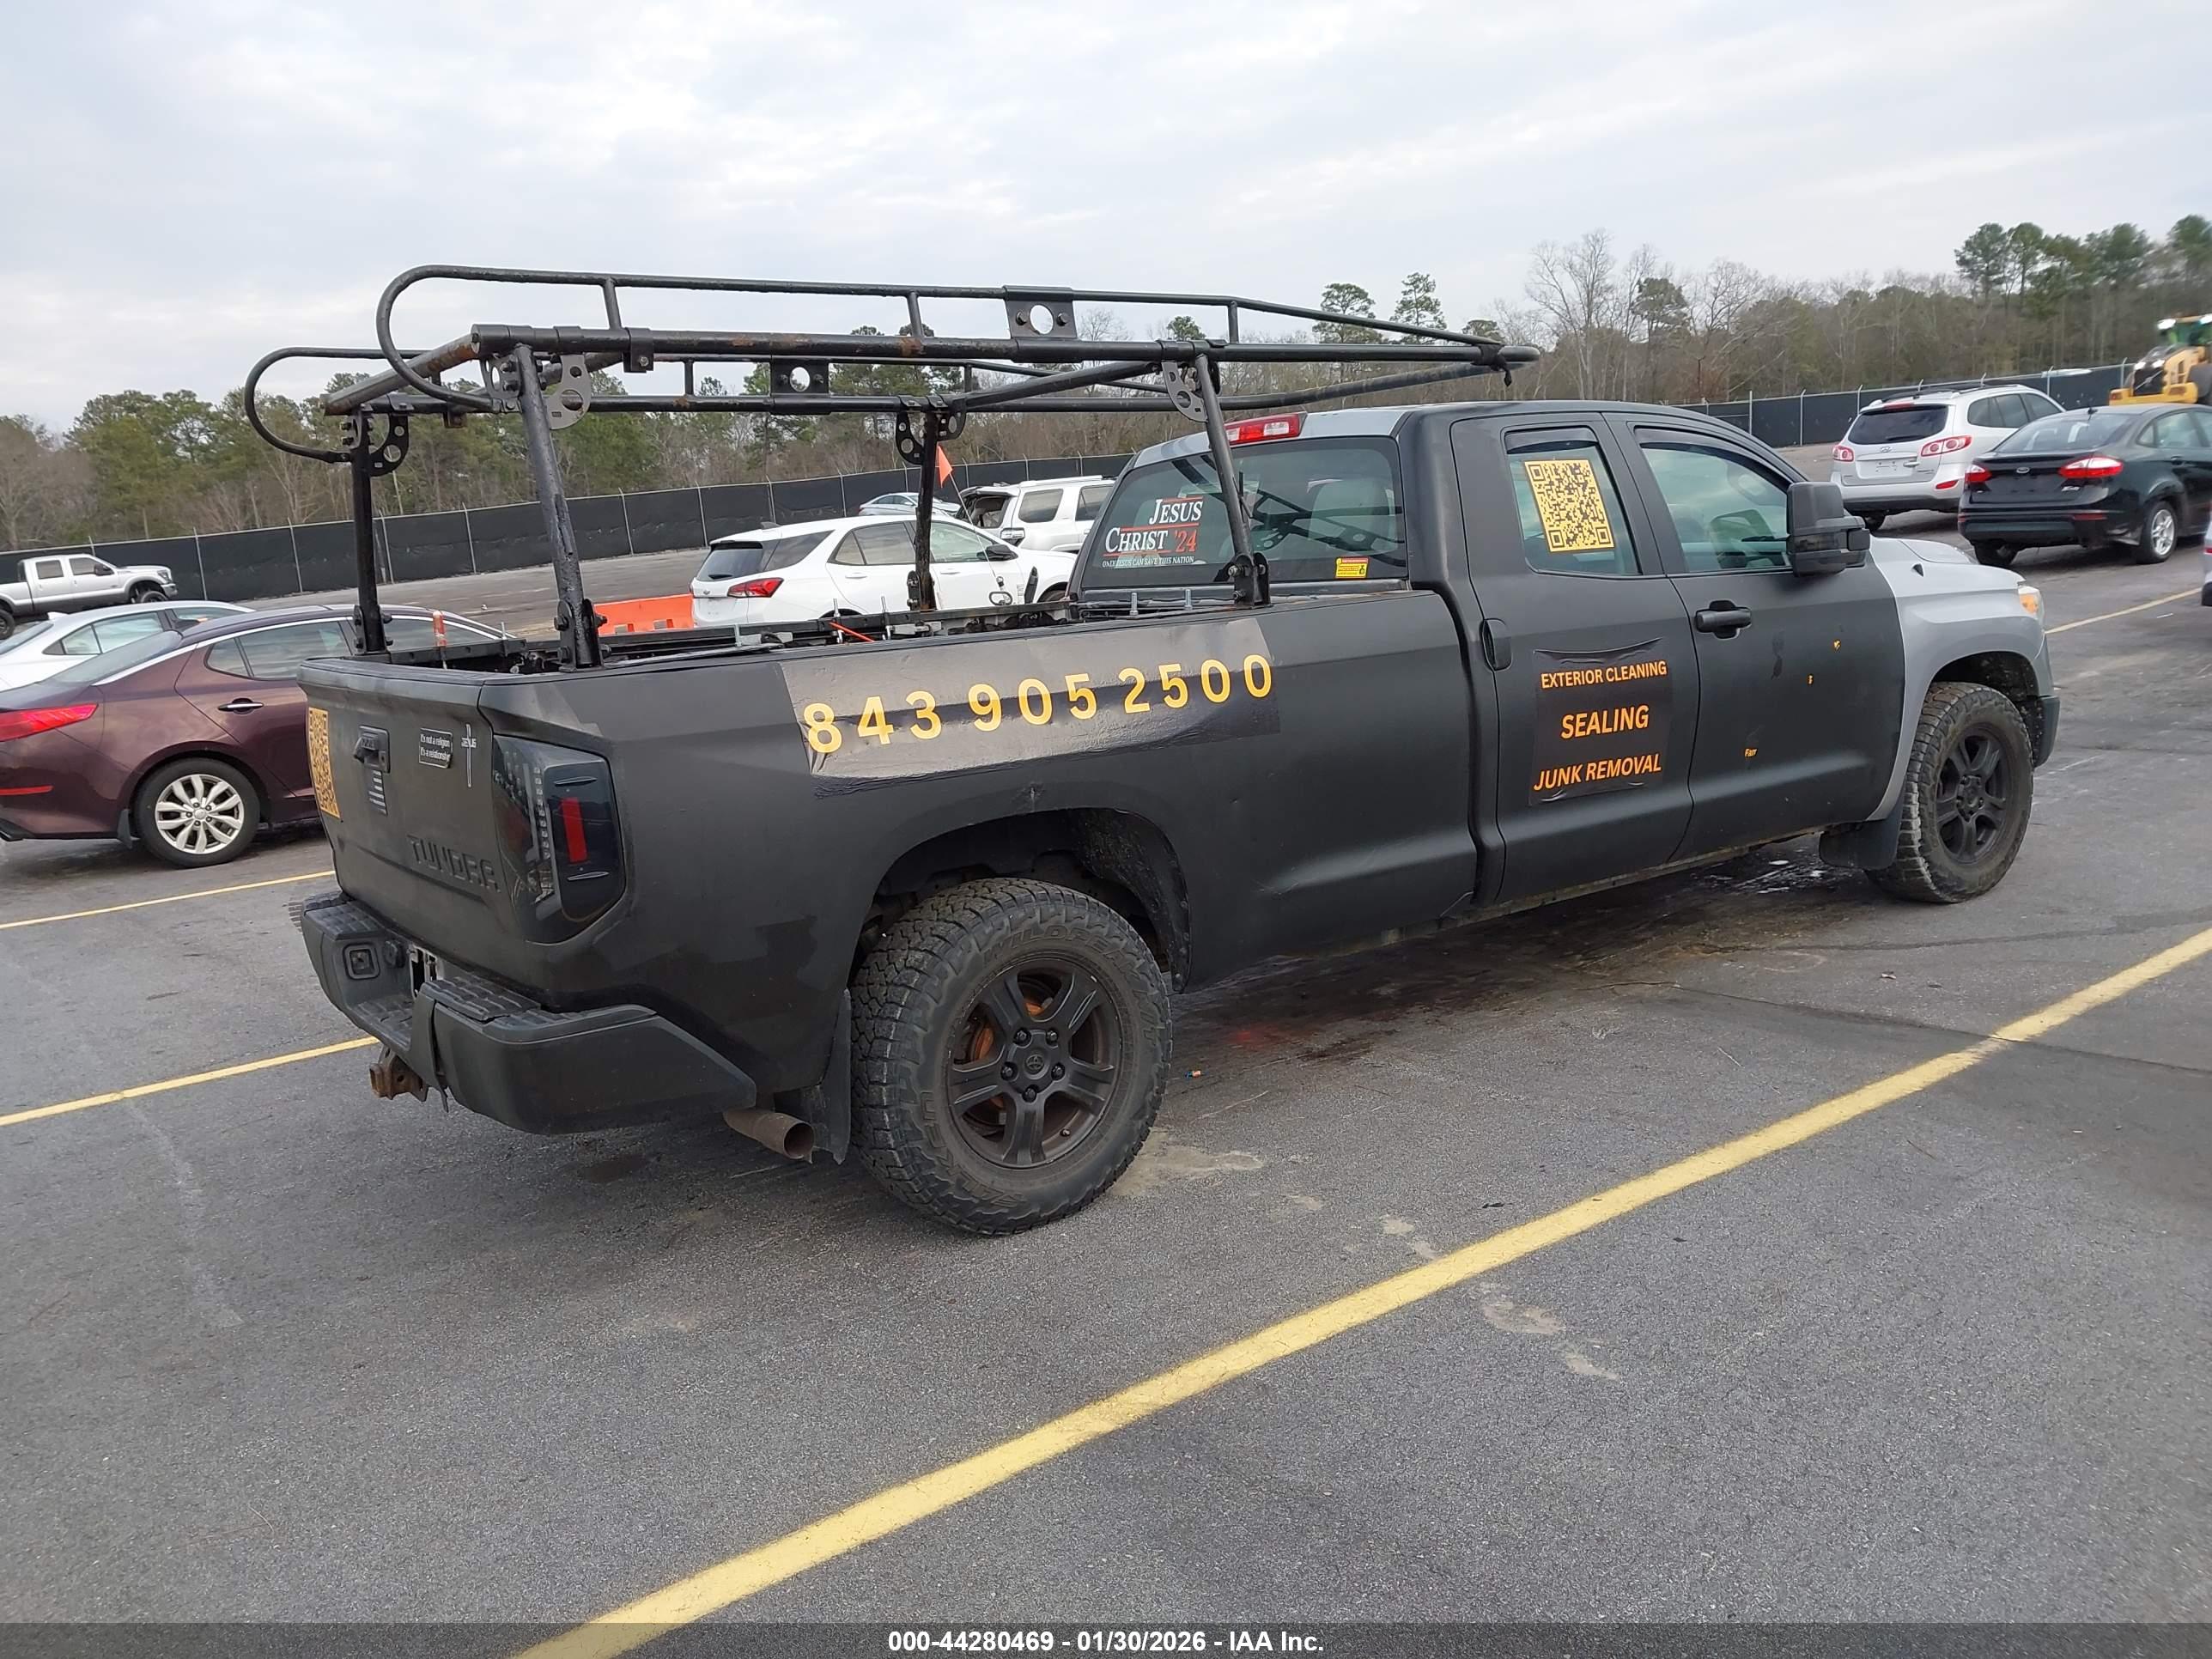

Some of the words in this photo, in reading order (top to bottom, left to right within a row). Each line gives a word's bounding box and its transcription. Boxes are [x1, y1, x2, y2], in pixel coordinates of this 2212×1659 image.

[1149, 499, 1203, 525] JESUS
[1105, 527, 1168, 552] CHRIST
[1174, 529, 1197, 553] '24
[1144, 557, 1158, 566] SAVE
[1540, 668, 1604, 689] EXTERIOR
[1605, 660, 1668, 682] CLEANING
[803, 690, 943, 754] 843
[967, 672, 1097, 732] 905
[1118, 653, 1273, 714] 2500
[1560, 704, 1650, 739] SEALING
[1533, 764, 1583, 791] JUNK
[1585, 753, 1662, 781] REMOVAL
